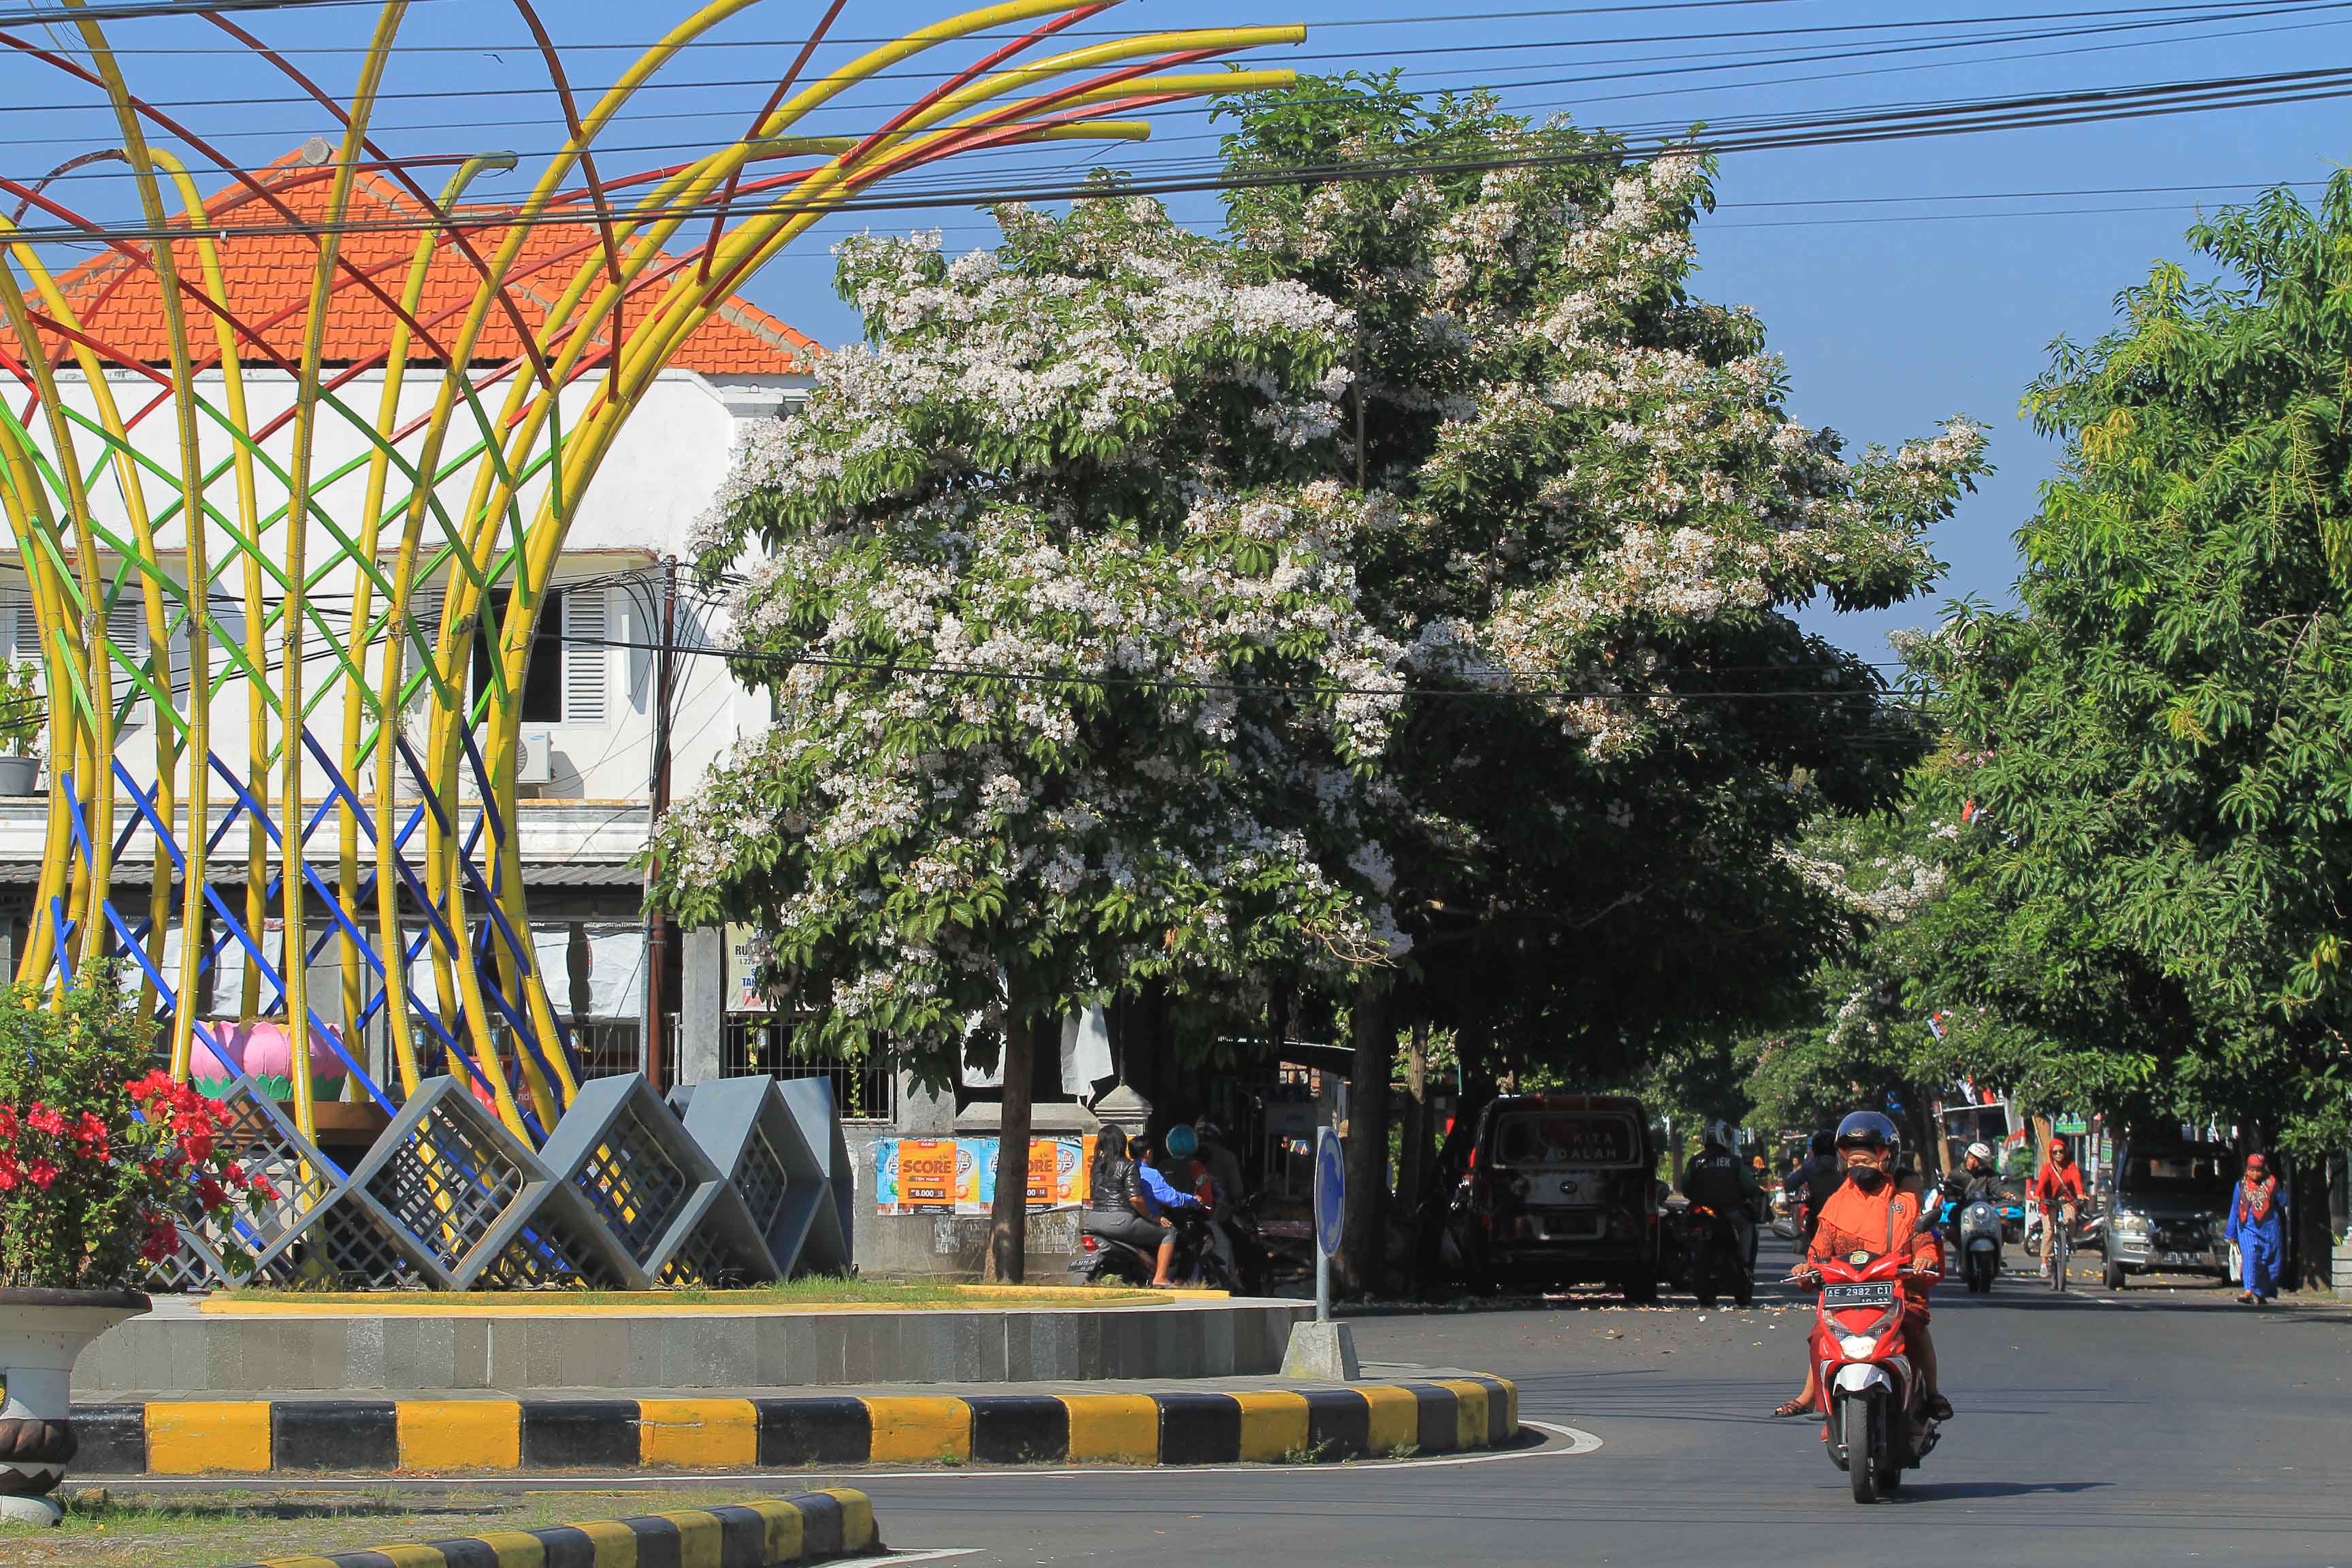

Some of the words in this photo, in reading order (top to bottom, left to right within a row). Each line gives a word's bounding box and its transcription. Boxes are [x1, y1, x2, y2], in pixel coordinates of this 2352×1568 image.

[1573, 1134, 1613, 1144] KITA
[1546, 1148, 1617, 1160] ADALAH
[903, 1160, 951, 1173] SCORE
[1828, 1289, 1840, 1297] AE
[1877, 1286, 1888, 1294] CI
